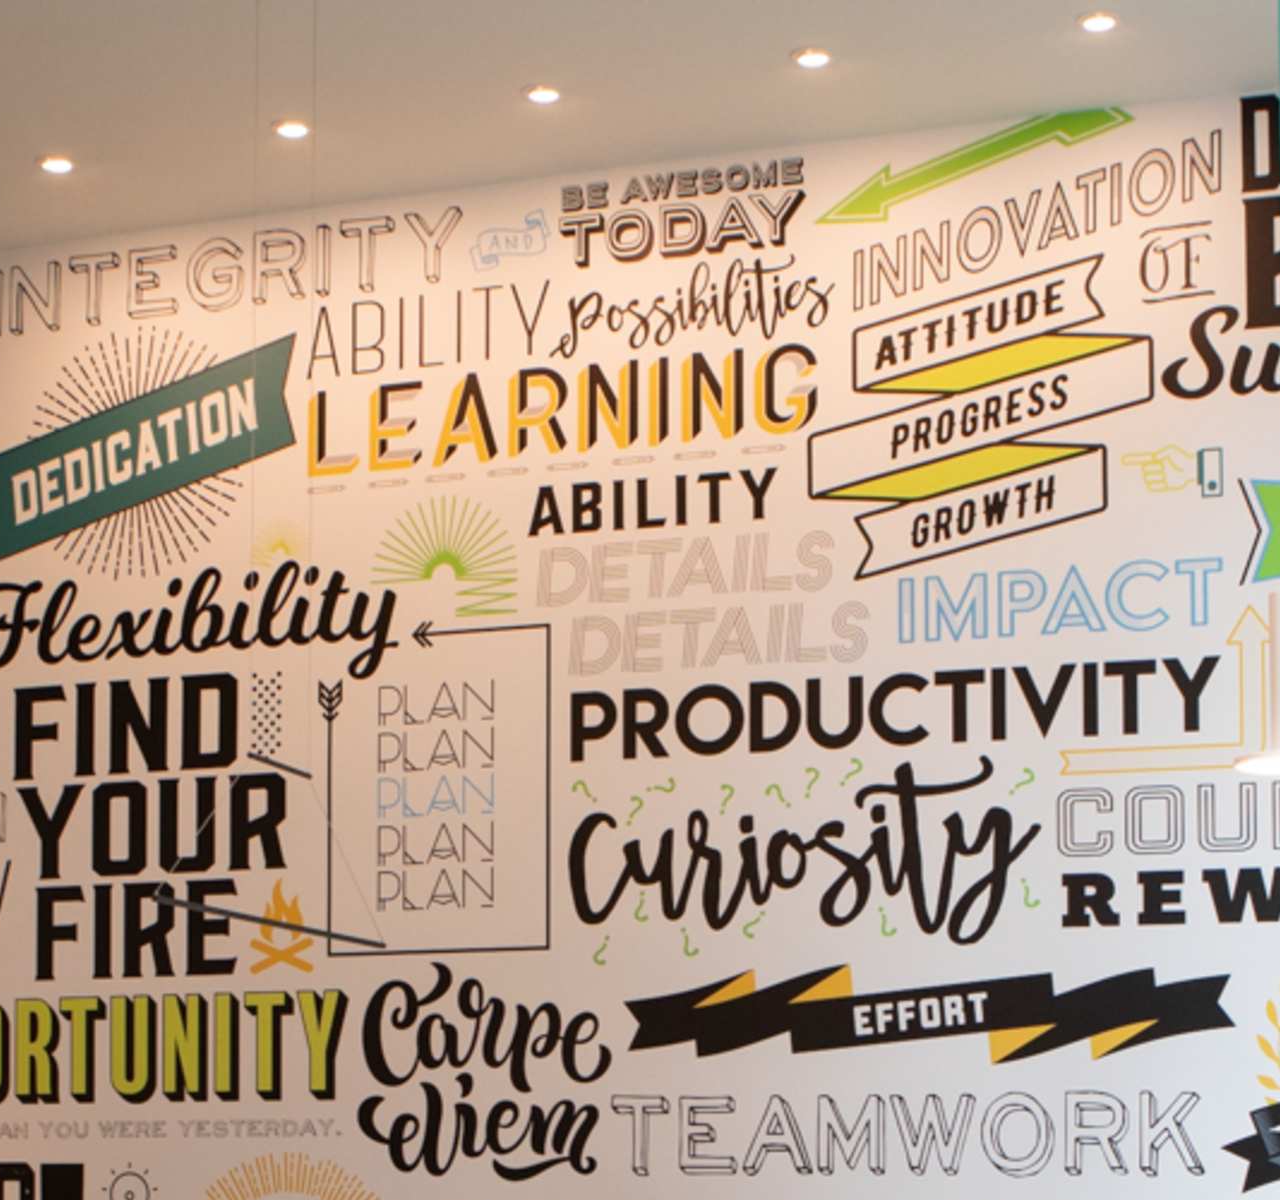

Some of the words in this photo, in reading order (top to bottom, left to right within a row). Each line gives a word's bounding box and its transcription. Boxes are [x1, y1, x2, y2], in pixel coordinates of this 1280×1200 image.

[561, 184, 609, 211] BE
[621, 157, 804, 204] AWESOME
[852, 129, 1223, 311] INNOVATION
[488, 232, 534, 252] AND
[559, 189, 807, 267] TODAY
[307, 279, 550, 379] ABILITY
[874, 279, 1066, 371] ATTITUDE
[10, 378, 259, 527] DEDICATION
[307, 343, 819, 479] LEARNING
[890, 374, 1069, 459] PROGRESS
[528, 466, 777, 537] ABILITY
[910, 474, 1056, 549] GROWTH
[535, 530, 835, 608] DETAILS
[897, 558, 1223, 644] IMPACT
[568, 600, 870, 677] DETAILS
[13, 672, 239, 780] FIND
[376, 678, 496, 726] PLAN
[570, 656, 1221, 763] PRODUCTIVITY
[376, 726, 496, 772] PLAN
[17, 772, 287, 880] YOUR
[376, 773, 496, 818] PLAN
[376, 820, 496, 866] PLAN
[567, 755, 1042, 945] Curiosity
[34, 878, 239, 981] FIRE
[376, 866, 496, 912] PLAN
[362, 962, 612, 1093] Carpe
[852, 991, 989, 1037] EFFORT
[37, 1120, 90, 1141] YOU
[98, 1119, 168, 1141] WERE
[178, 1118, 343, 1140] YESTERDAY.
[357, 1073, 600, 1182] diem
[611, 1090, 1206, 1178] TEAMWORK
